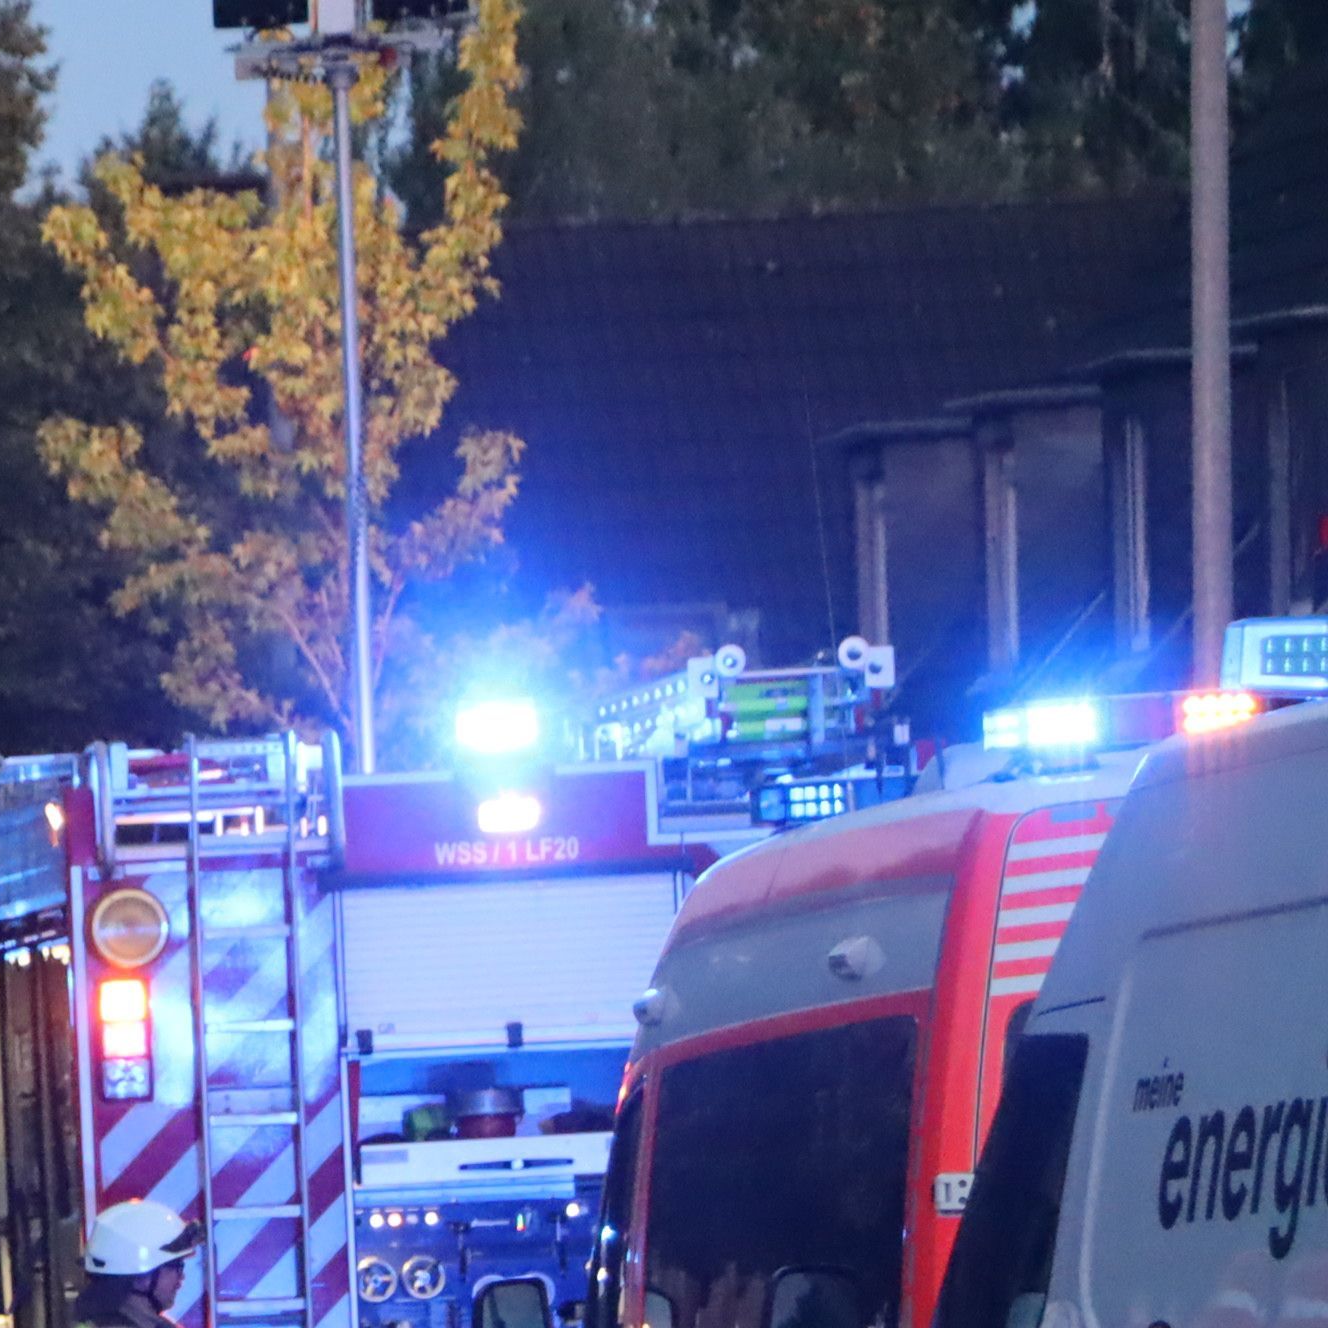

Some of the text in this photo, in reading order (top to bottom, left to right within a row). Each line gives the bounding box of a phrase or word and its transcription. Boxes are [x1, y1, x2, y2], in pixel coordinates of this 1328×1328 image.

[434, 841, 488, 866] WSS
[525, 836, 579, 861] LF20
[1133, 1057, 1185, 1112] meine
[1158, 1095, 1328, 1260] energi
